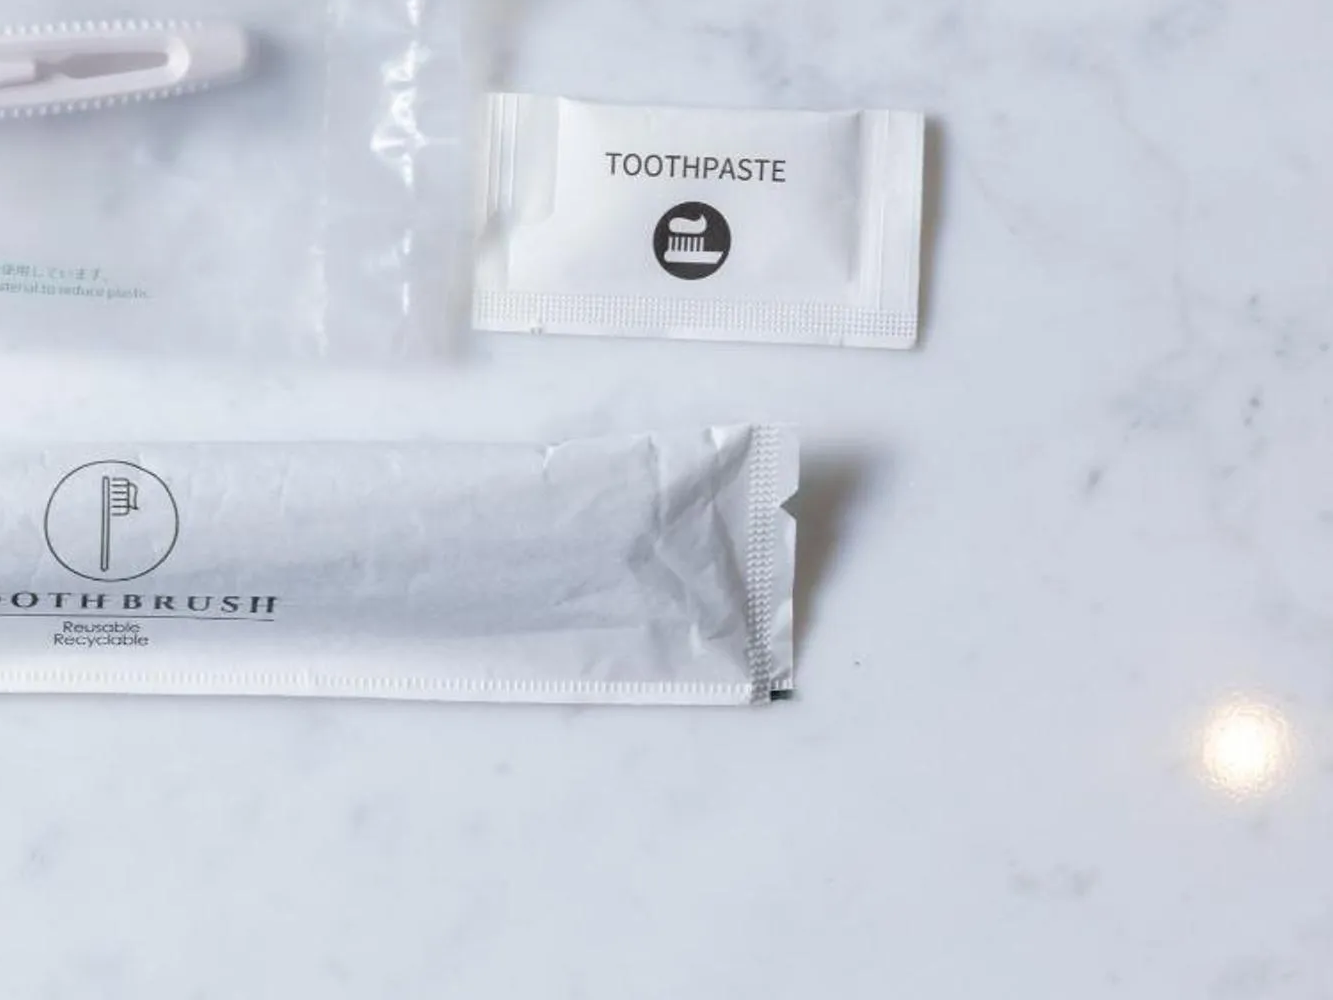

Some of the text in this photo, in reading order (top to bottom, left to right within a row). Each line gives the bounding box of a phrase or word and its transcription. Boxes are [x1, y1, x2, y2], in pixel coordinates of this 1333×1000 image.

[605, 152, 787, 183] TOOTHPASTE
[62, 620, 142, 634] Reusable
[54, 632, 150, 647] Recyclable
